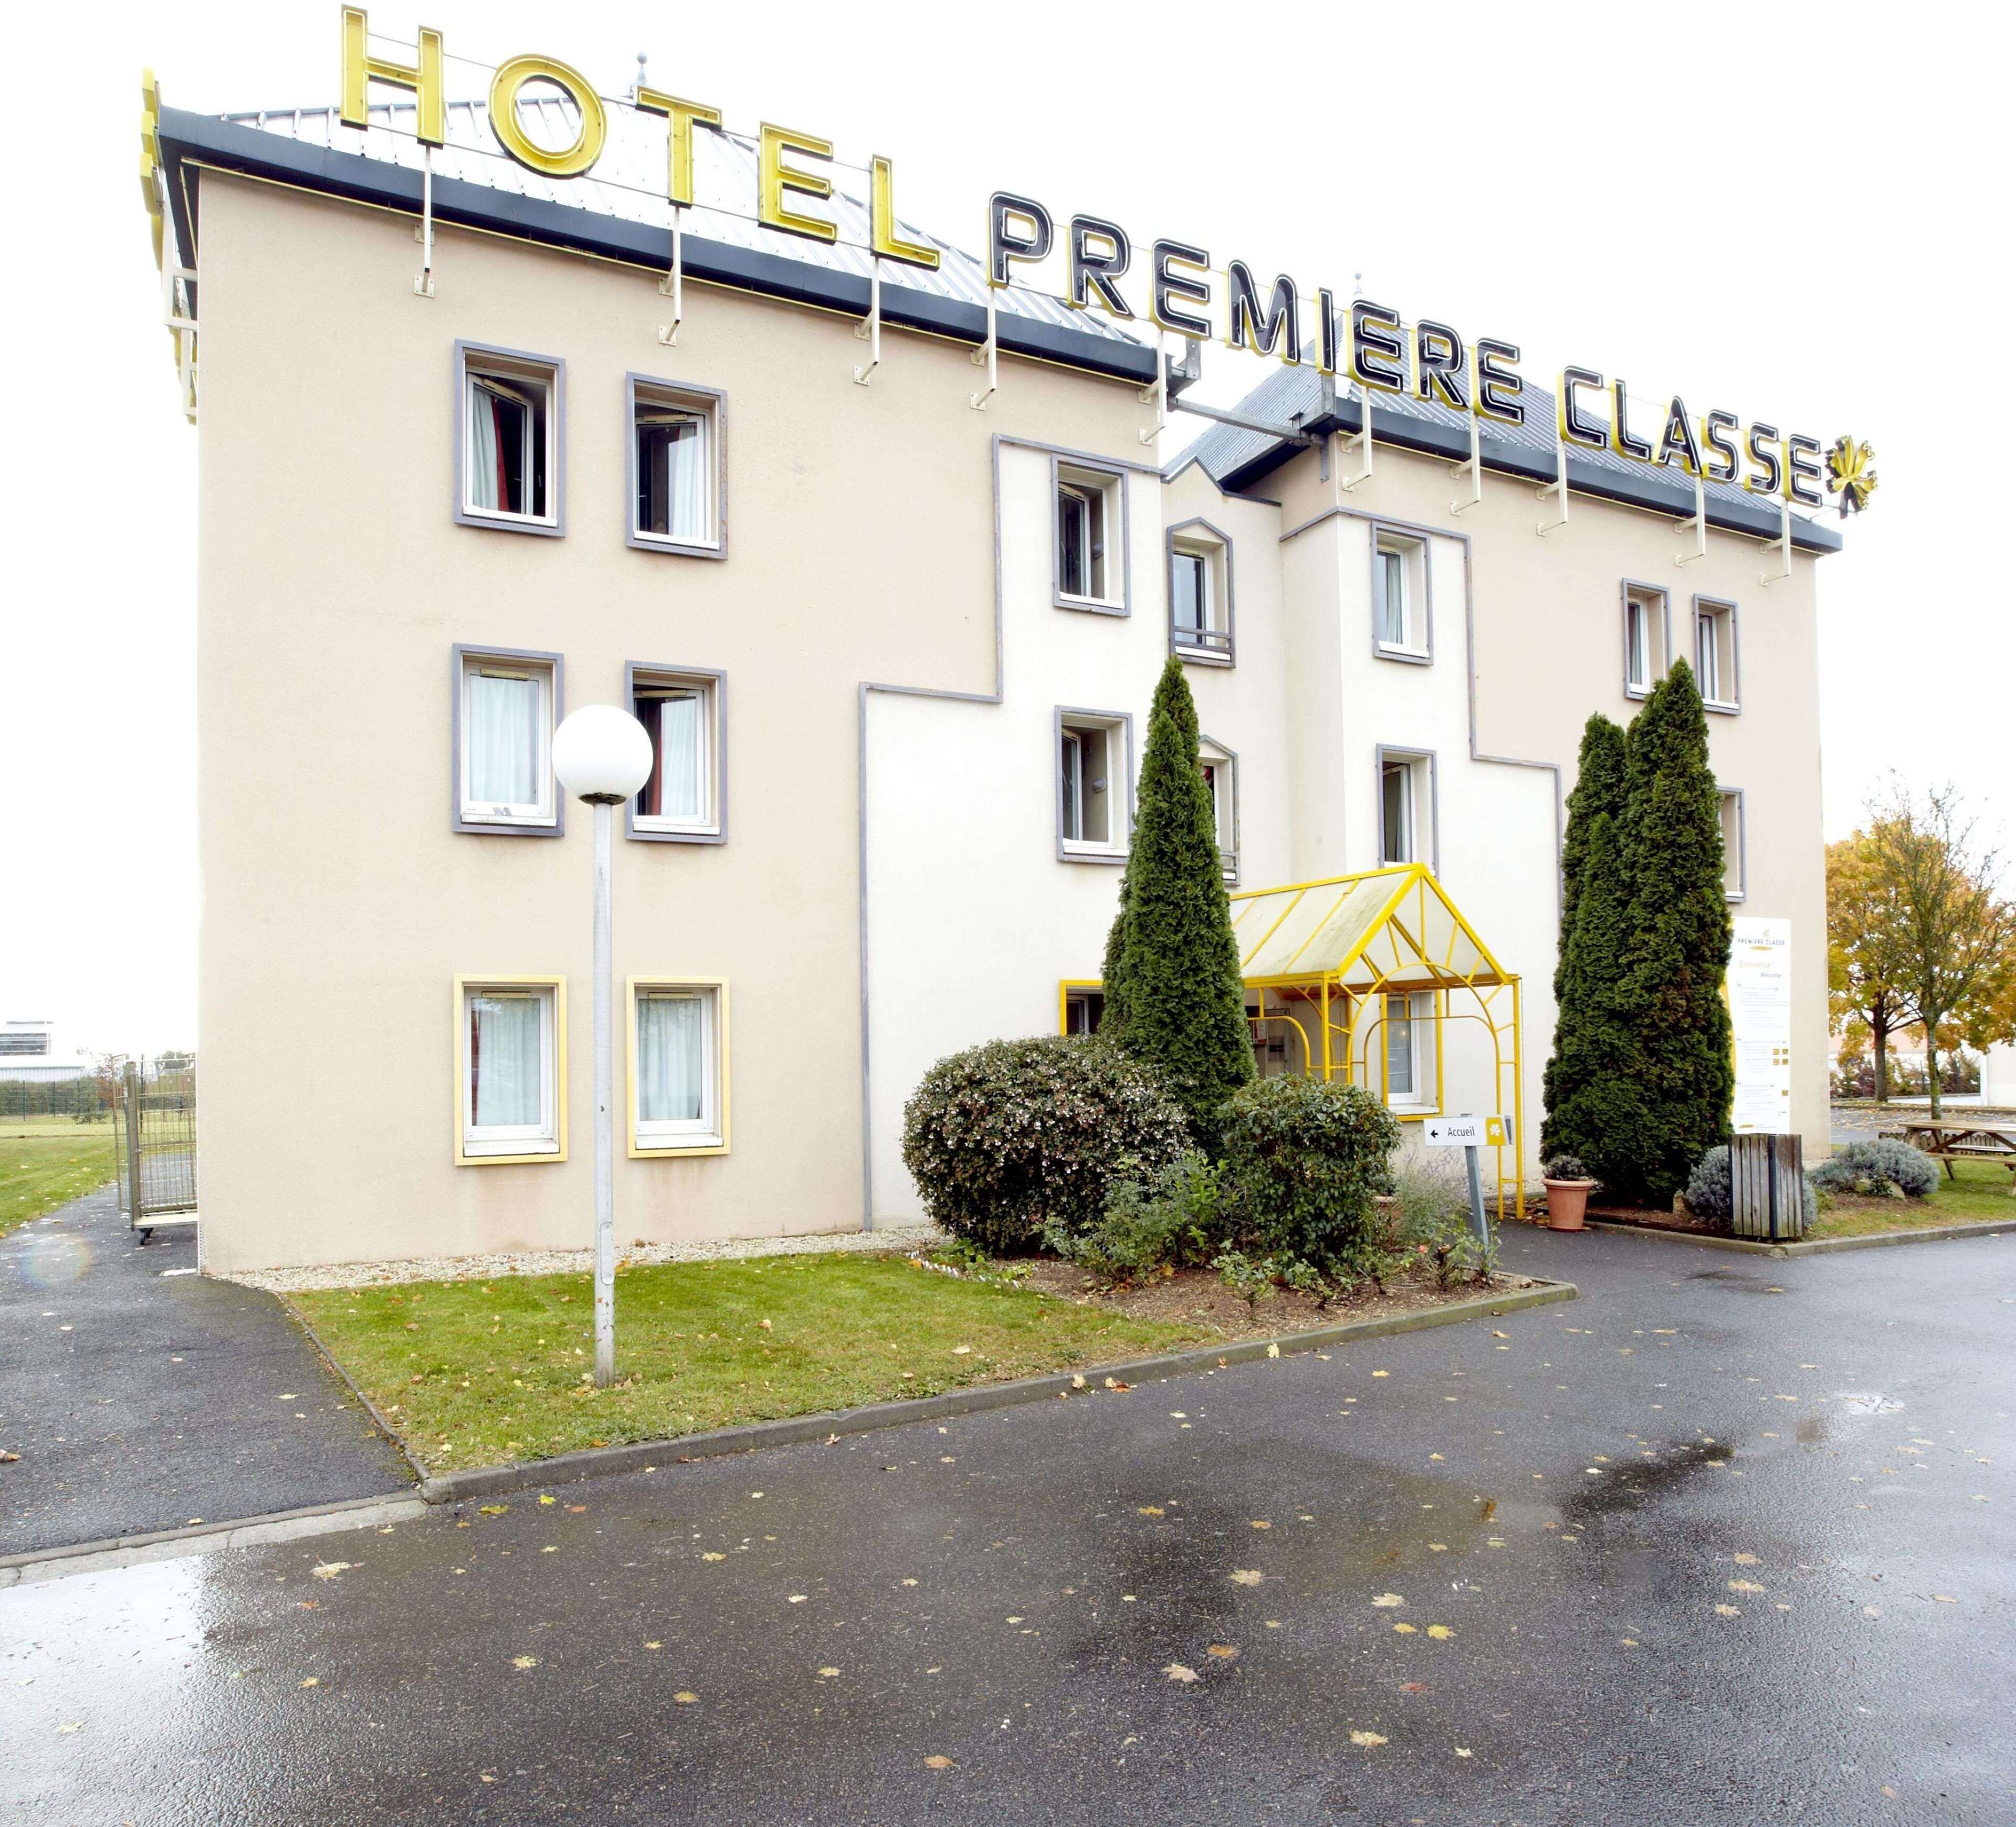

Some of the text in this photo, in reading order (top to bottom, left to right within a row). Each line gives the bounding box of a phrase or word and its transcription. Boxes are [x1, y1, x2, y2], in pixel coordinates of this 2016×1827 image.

[340, 4, 1822, 508] HOTEL PREMIERE CLASSE
[1448, 1126, 1475, 1137] Accueil
